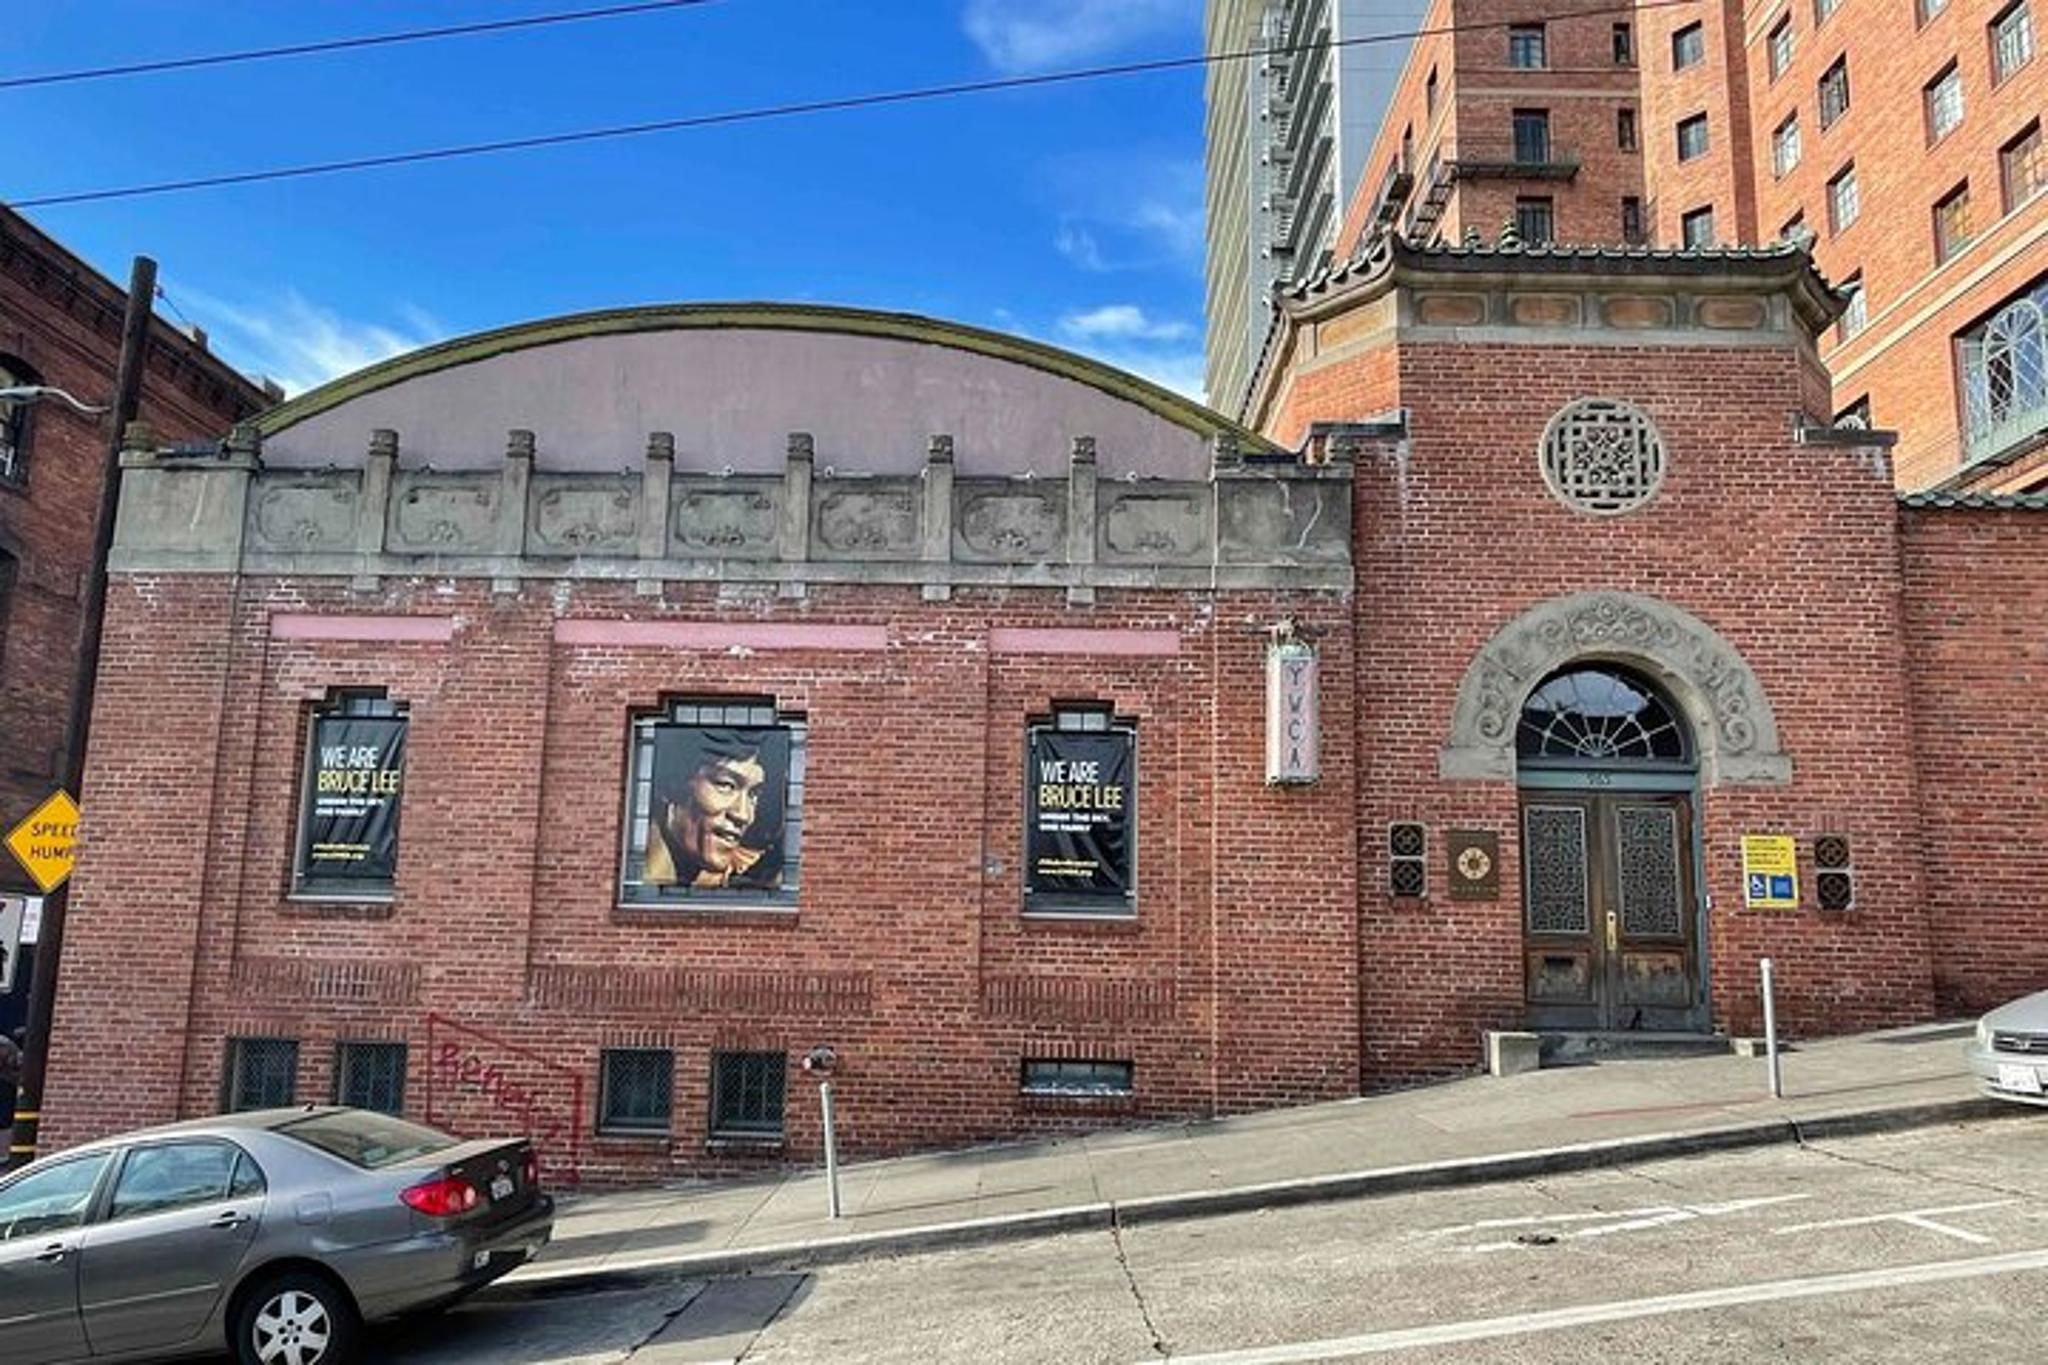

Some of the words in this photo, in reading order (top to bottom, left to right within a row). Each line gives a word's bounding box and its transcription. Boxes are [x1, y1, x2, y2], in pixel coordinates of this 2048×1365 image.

[1287, 666, 1304, 769] YWCA
[320, 745, 347, 768] WE
[347, 745, 379, 768] ARE
[317, 769, 370, 793] BRUCE
[372, 769, 401, 793] LEE
[1040, 760, 1067, 783] WE
[1068, 760, 1100, 784] ARE
[1039, 784, 1092, 808] BRUCE
[1094, 785, 1123, 809] LEE
